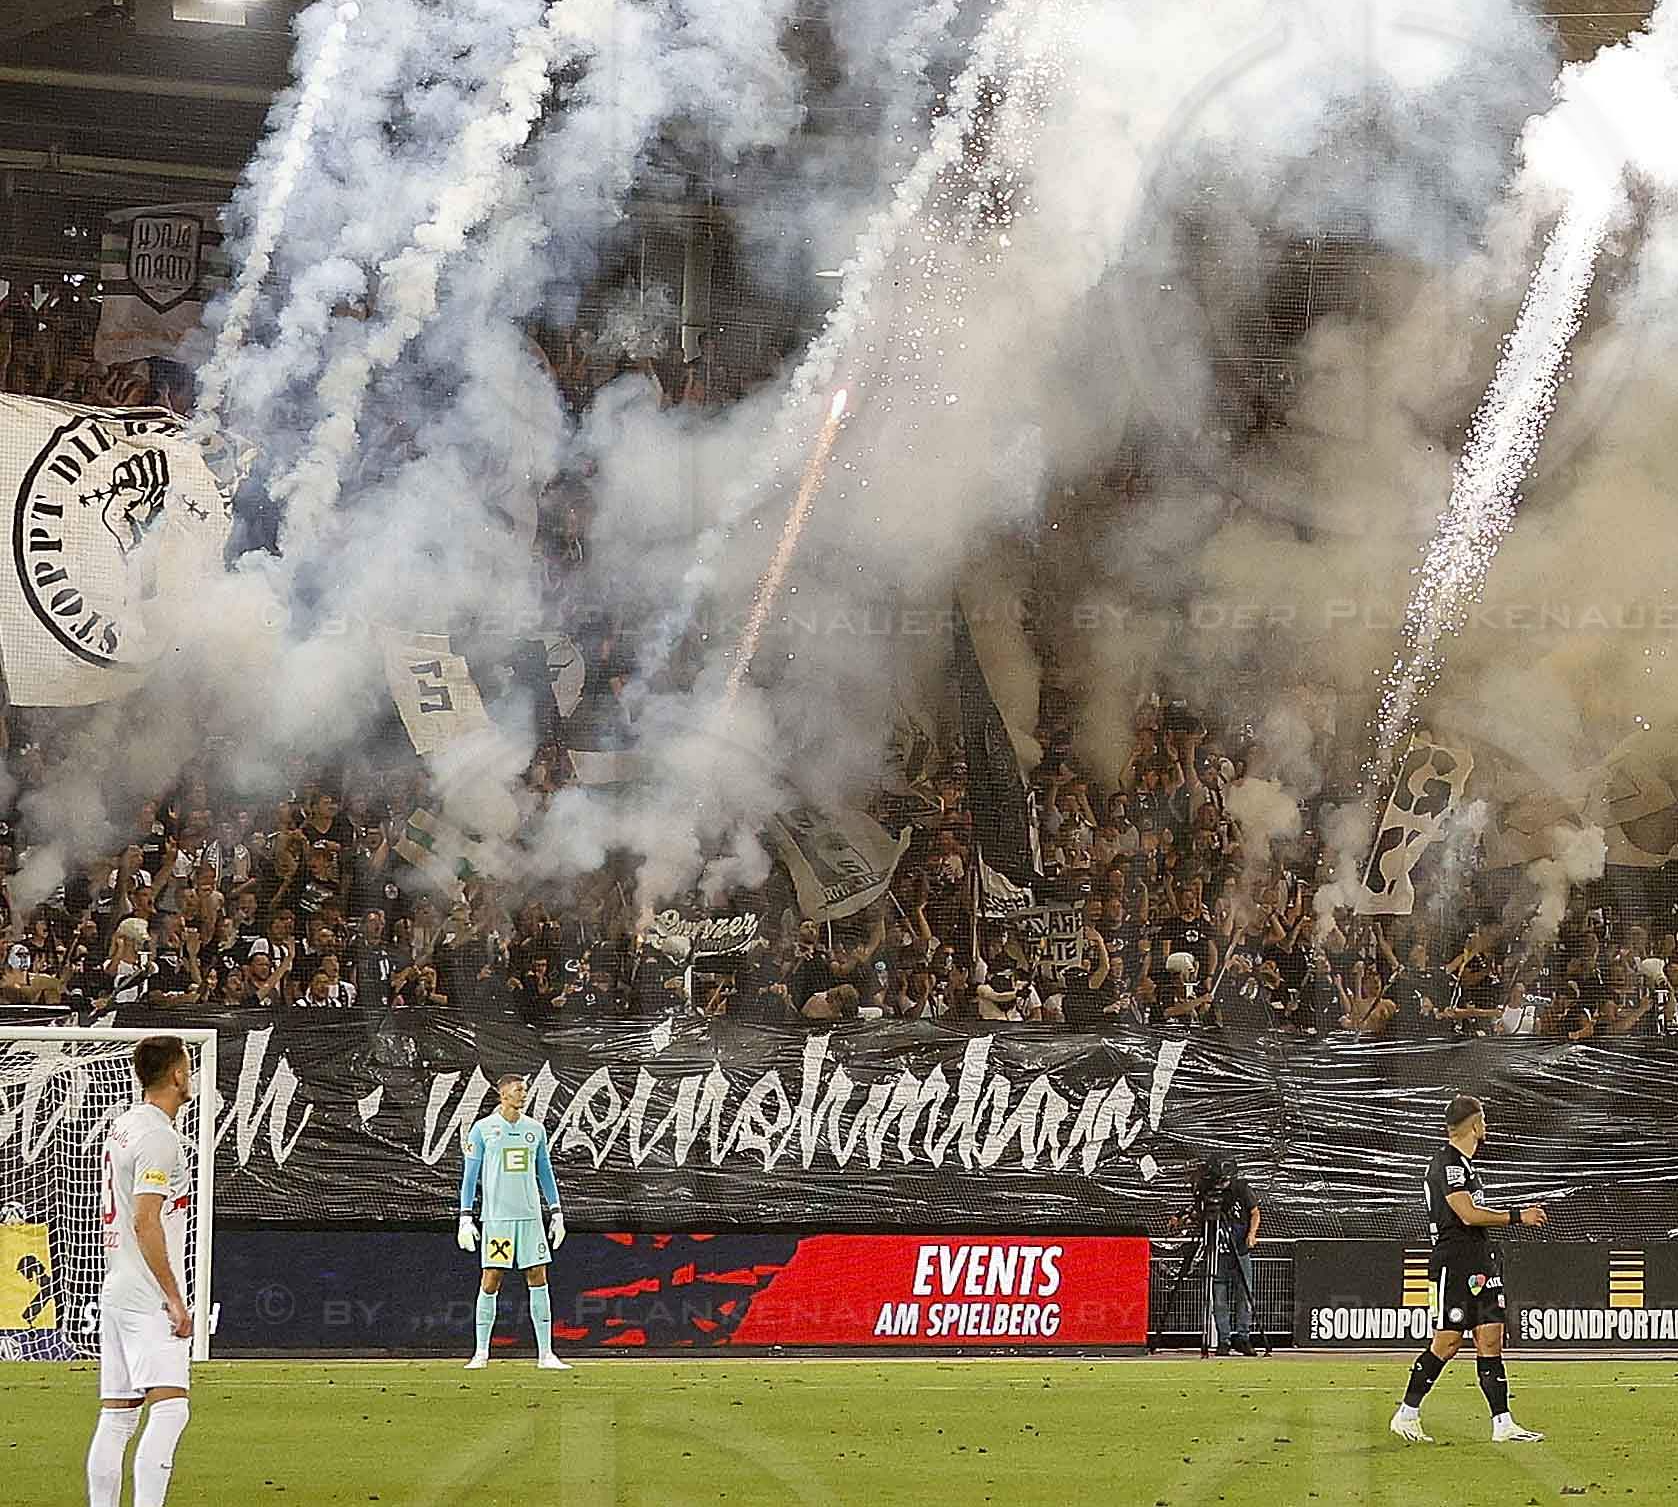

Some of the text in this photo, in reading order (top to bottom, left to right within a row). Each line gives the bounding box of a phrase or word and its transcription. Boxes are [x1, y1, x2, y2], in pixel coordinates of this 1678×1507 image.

[912, 1245, 1064, 1296] EVENTS
[873, 1303, 1061, 1337] AM SPIELBERG
[1311, 1309, 1319, 1339] RADIO
